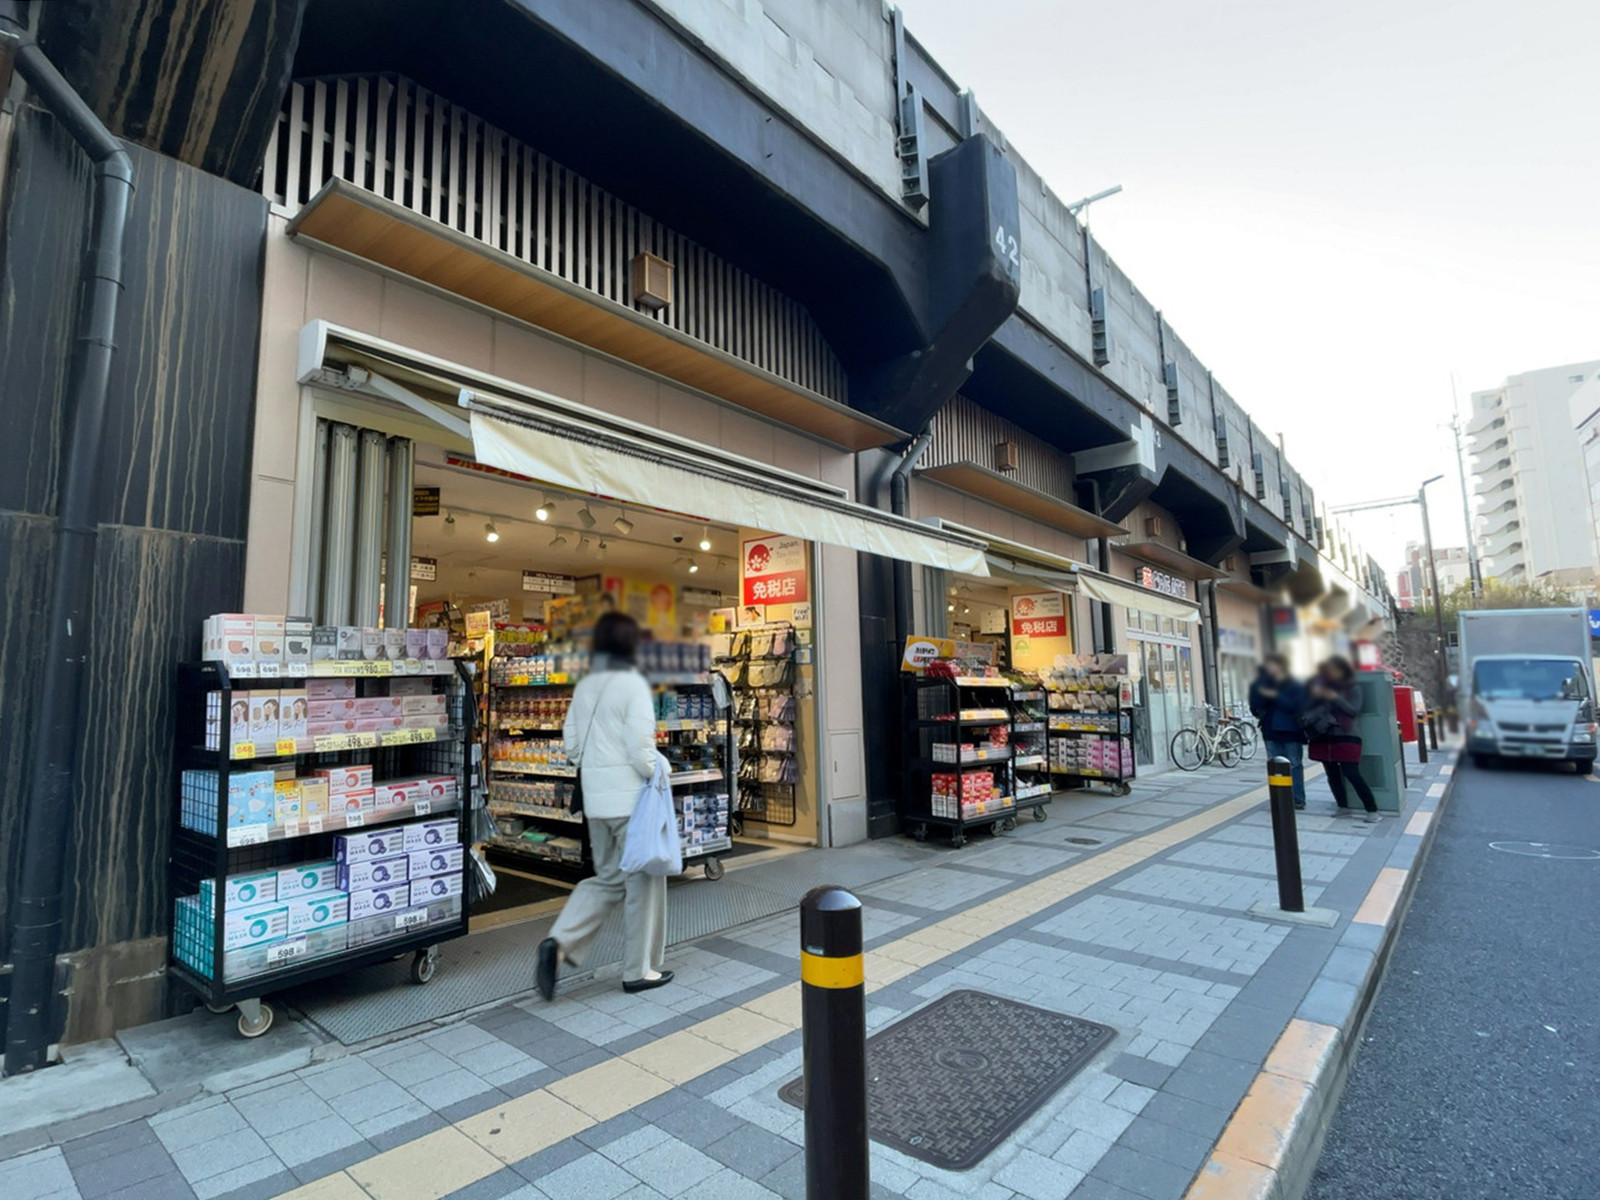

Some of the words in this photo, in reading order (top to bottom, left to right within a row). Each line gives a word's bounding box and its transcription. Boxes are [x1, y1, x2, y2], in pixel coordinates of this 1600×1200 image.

[995, 225, 1019, 266] 42
[752, 578, 796, 600] 免税店
[1021, 620, 1058, 634] 免税店
[347, 736, 362, 747] 498
[404, 916, 418, 926] 598
[278, 948, 295, 958] 598
